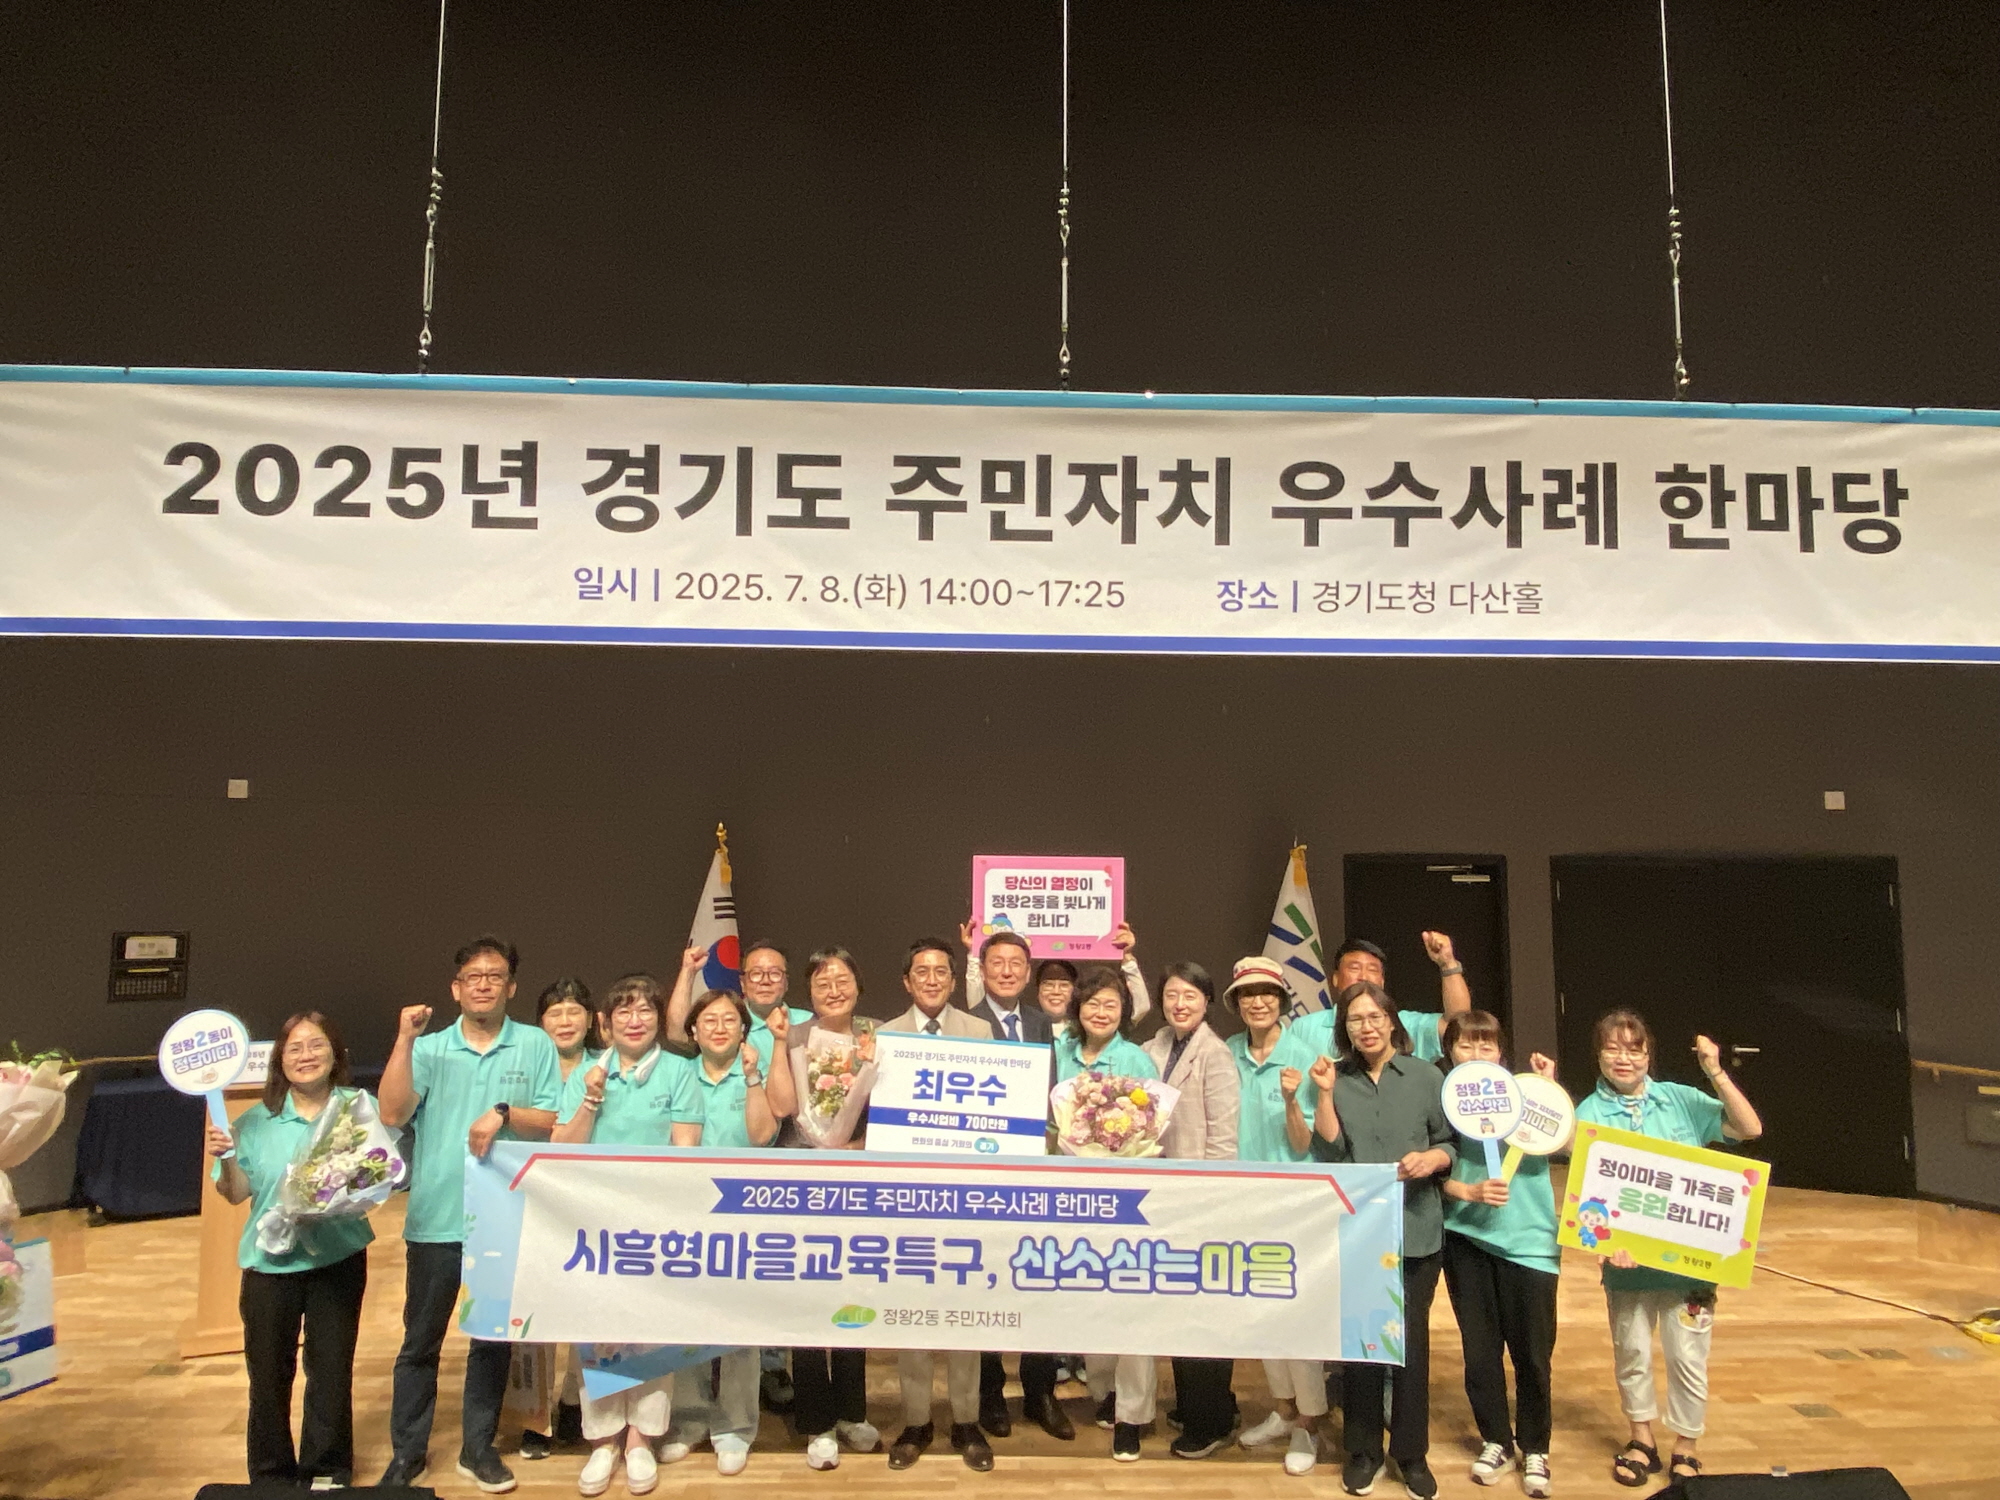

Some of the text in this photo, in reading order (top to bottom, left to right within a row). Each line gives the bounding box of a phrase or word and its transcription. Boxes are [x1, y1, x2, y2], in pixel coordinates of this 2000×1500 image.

[162, 440, 1909, 555] 2025년 경기도 주민자치 우수사례 한마당
[573, 566, 1544, 616] 일시 2025. 7. 8.(화) 14:00~17:25 장소 경기도청 다산홀
[1005, 876, 1093, 891] 당신의 열정이
[992, 894, 1106, 910] 정왕2동을 빛나게
[1027, 914, 1070, 928] 합니다
[170, 1026, 233, 1055] 정왕2동이
[172, 1041, 239, 1075] 정답이다!
[893, 1050, 1031, 1069] 2025년 경기도 주민자치 우수사례 한마당
[912, 1068, 1007, 1106] 최우수
[1455, 1077, 1507, 1098] 정왕2동
[907, 1111, 1008, 1131] 우수사업비 700만원
[1457, 1097, 1512, 1116] 산소맛집
[1598, 1157, 1735, 1206] 정이마을 가족을
[742, 1185, 1119, 1219] 2025 경기도 주민자치 우수사례 한마당
[1618, 1187, 1731, 1233] 응원합니다!
[563, 1228, 1297, 1299] 시흥형마을교육특구, 산소심는마을
[883, 1308, 1021, 1330] 정왕2동 주민자치회
